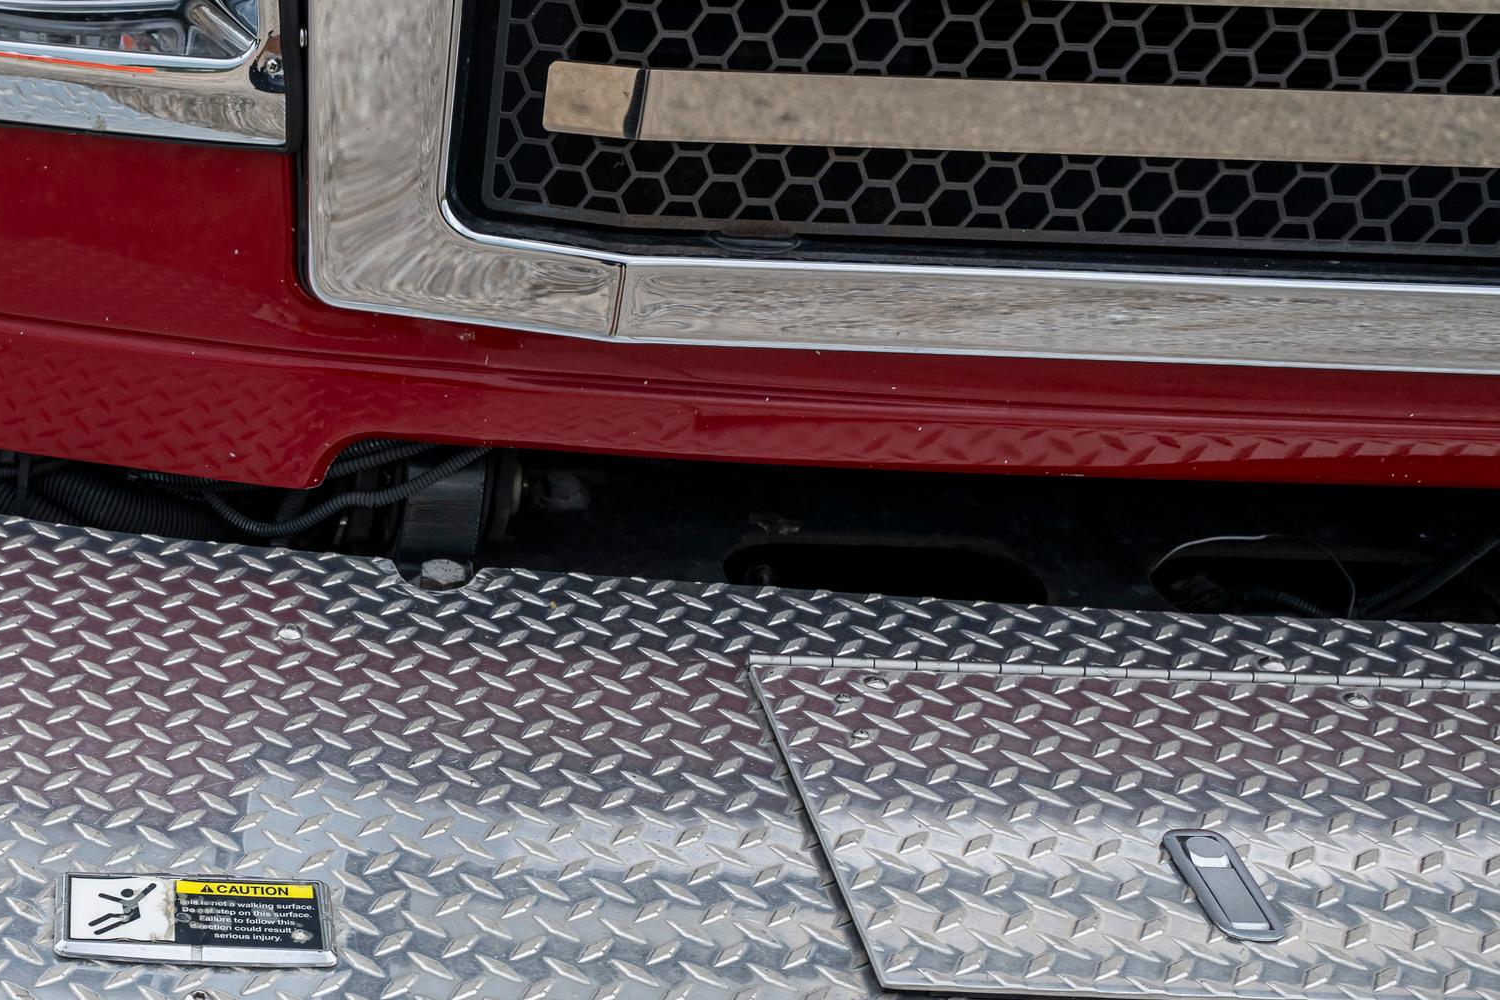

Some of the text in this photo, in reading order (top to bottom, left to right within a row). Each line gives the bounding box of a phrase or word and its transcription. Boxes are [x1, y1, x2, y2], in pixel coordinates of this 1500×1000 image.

[216, 884, 289, 896] CAUTION
[211, 900, 227, 908] not
[237, 902, 274, 911] walking
[276, 903, 315, 911] surface.
[181, 906, 196, 914] Do
[215, 908, 236, 916] step
[273, 911, 313, 919] surface.
[199, 914, 232, 923] Failure
[246, 917, 276, 925] follow
[234, 924, 262, 932] could
[264, 926, 292, 934] result
[214, 932, 283, 943] serious injury.
